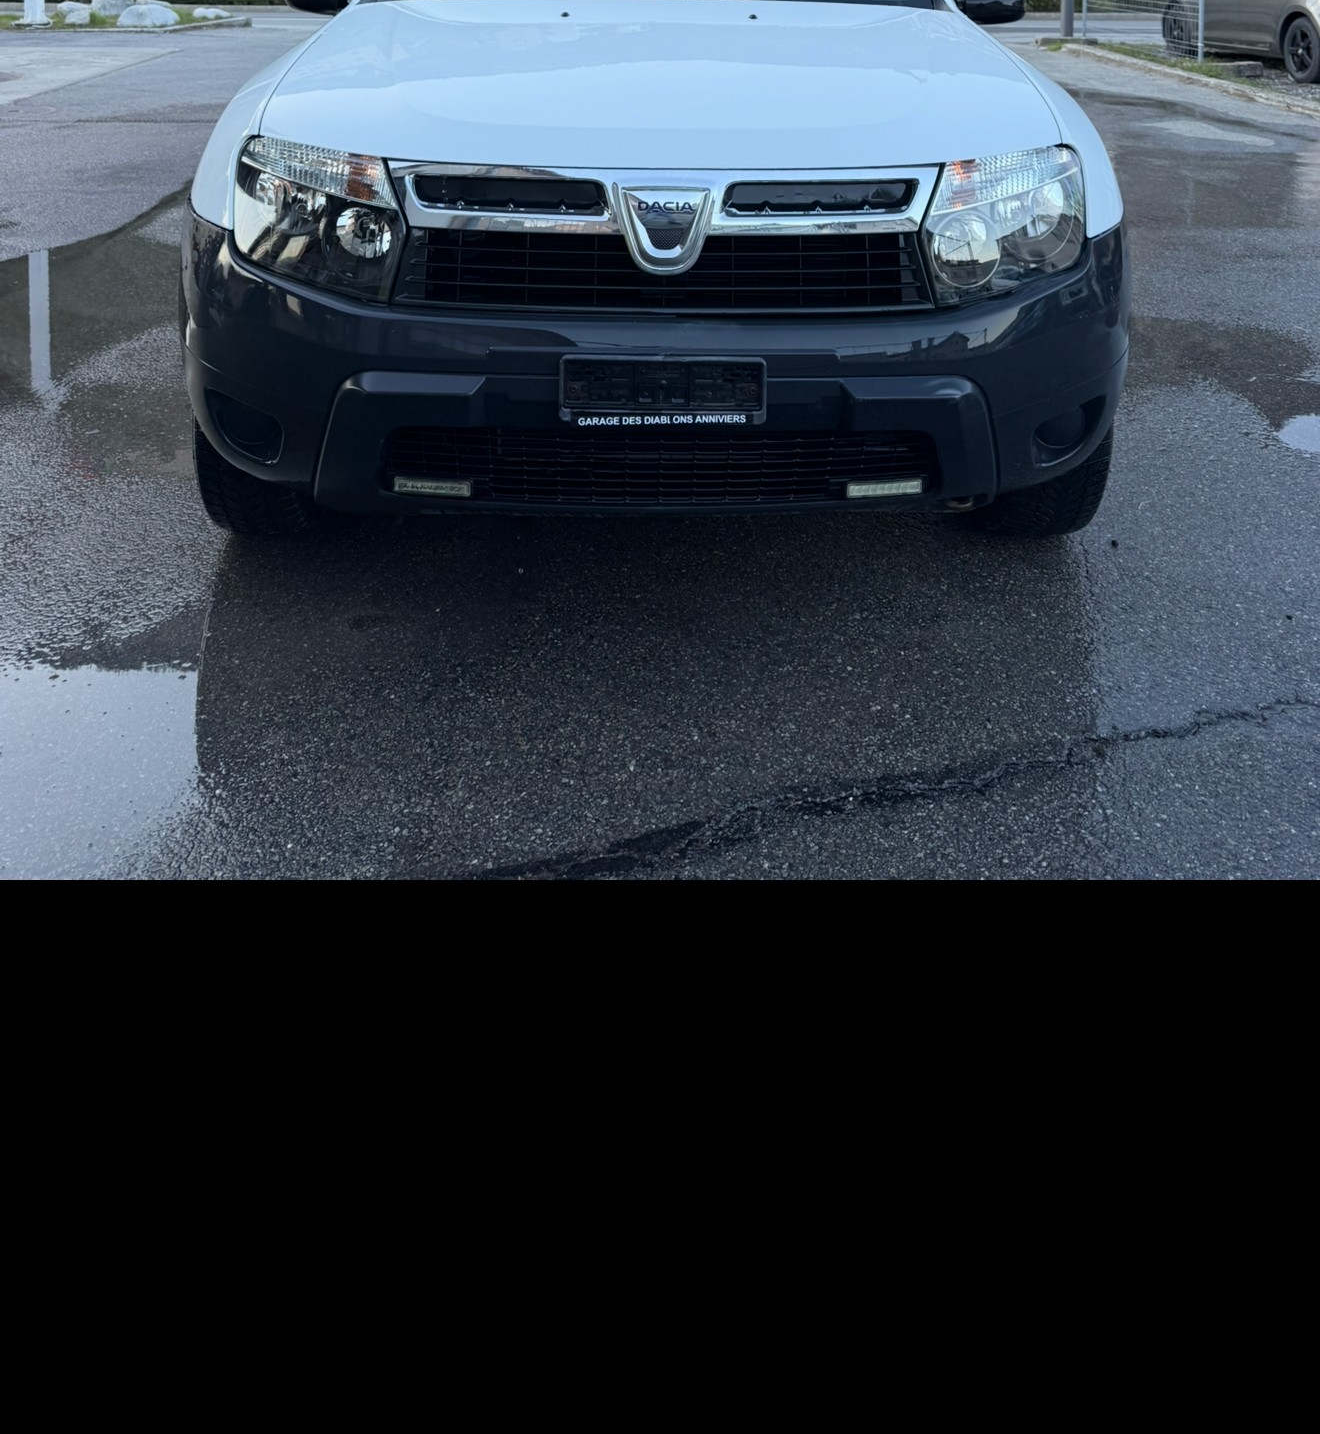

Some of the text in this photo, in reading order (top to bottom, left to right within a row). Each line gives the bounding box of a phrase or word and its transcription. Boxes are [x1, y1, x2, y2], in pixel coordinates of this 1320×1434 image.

[637, 201, 694, 213] DACIA
[578, 416, 620, 426] GARAGE
[622, 416, 642, 425] DES
[695, 414, 747, 424] ANNIVIERS
